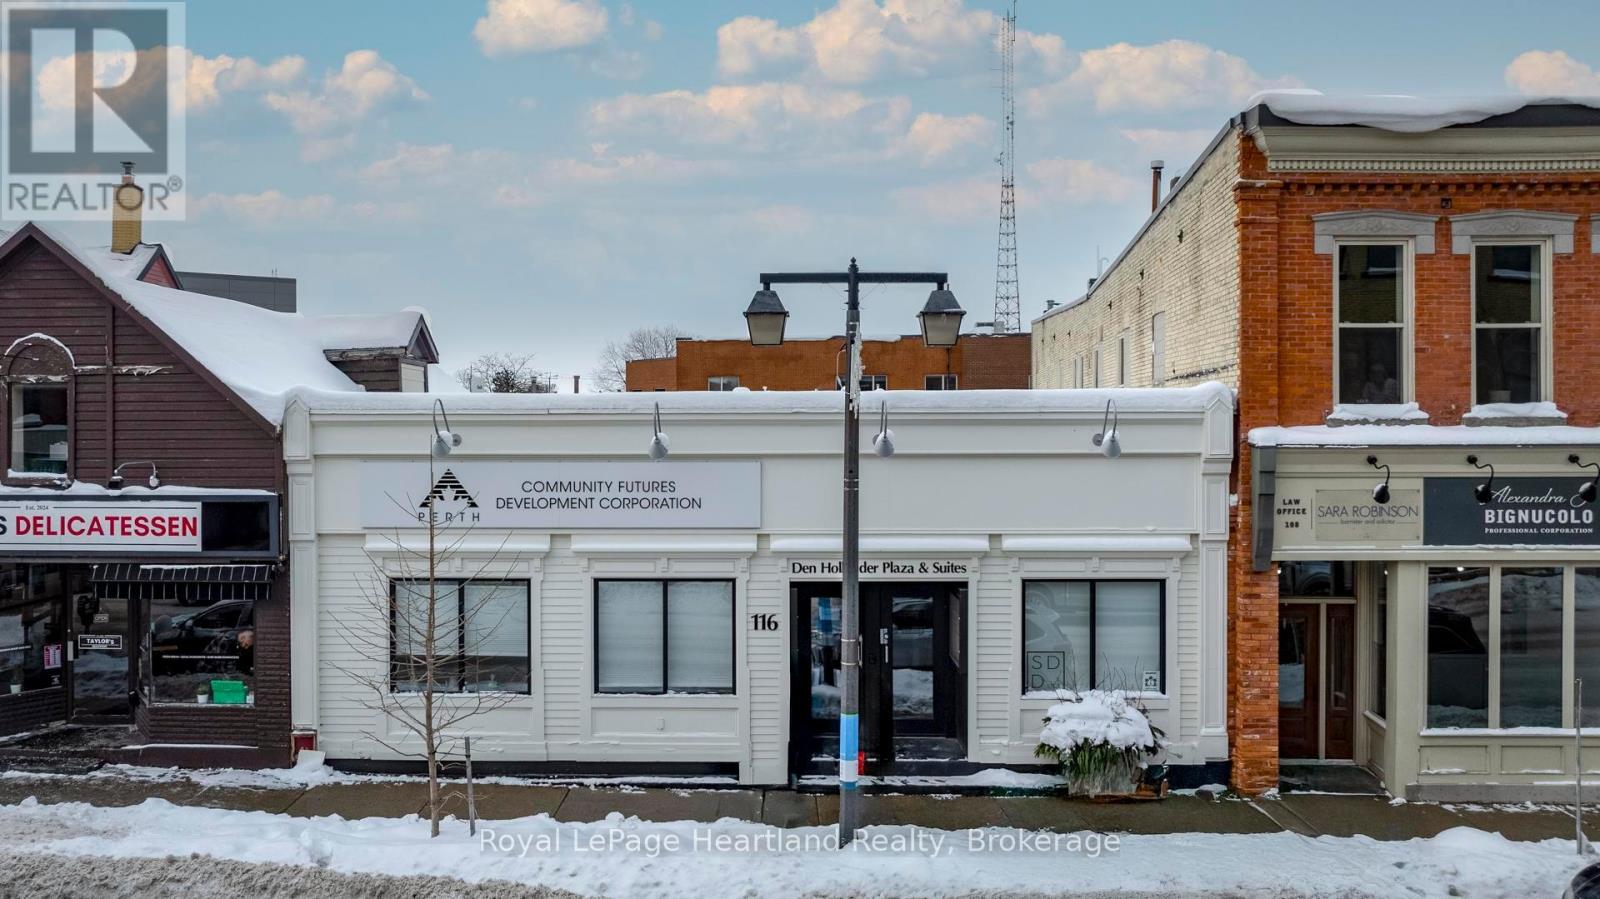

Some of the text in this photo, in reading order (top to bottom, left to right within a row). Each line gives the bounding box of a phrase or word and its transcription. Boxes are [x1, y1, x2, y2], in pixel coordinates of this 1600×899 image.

[521, 480, 676, 493] COMMUNITY FUTURES
[1490, 485, 1567, 504] Alexandra
[496, 497, 702, 510] DEVELOPMENT CORPORATION
[1282, 498, 1301, 506] LAW
[418, 511, 480, 522] PERTH
[1317, 505, 1419, 518] SARA ROBINSON
[1484, 509, 1594, 524] BIGNUCOLO
[15, 515, 198, 536] DELICATESSEN
[792, 561, 967, 574] Den Holder Plaza & Suites
[751, 614, 779, 631] 116
